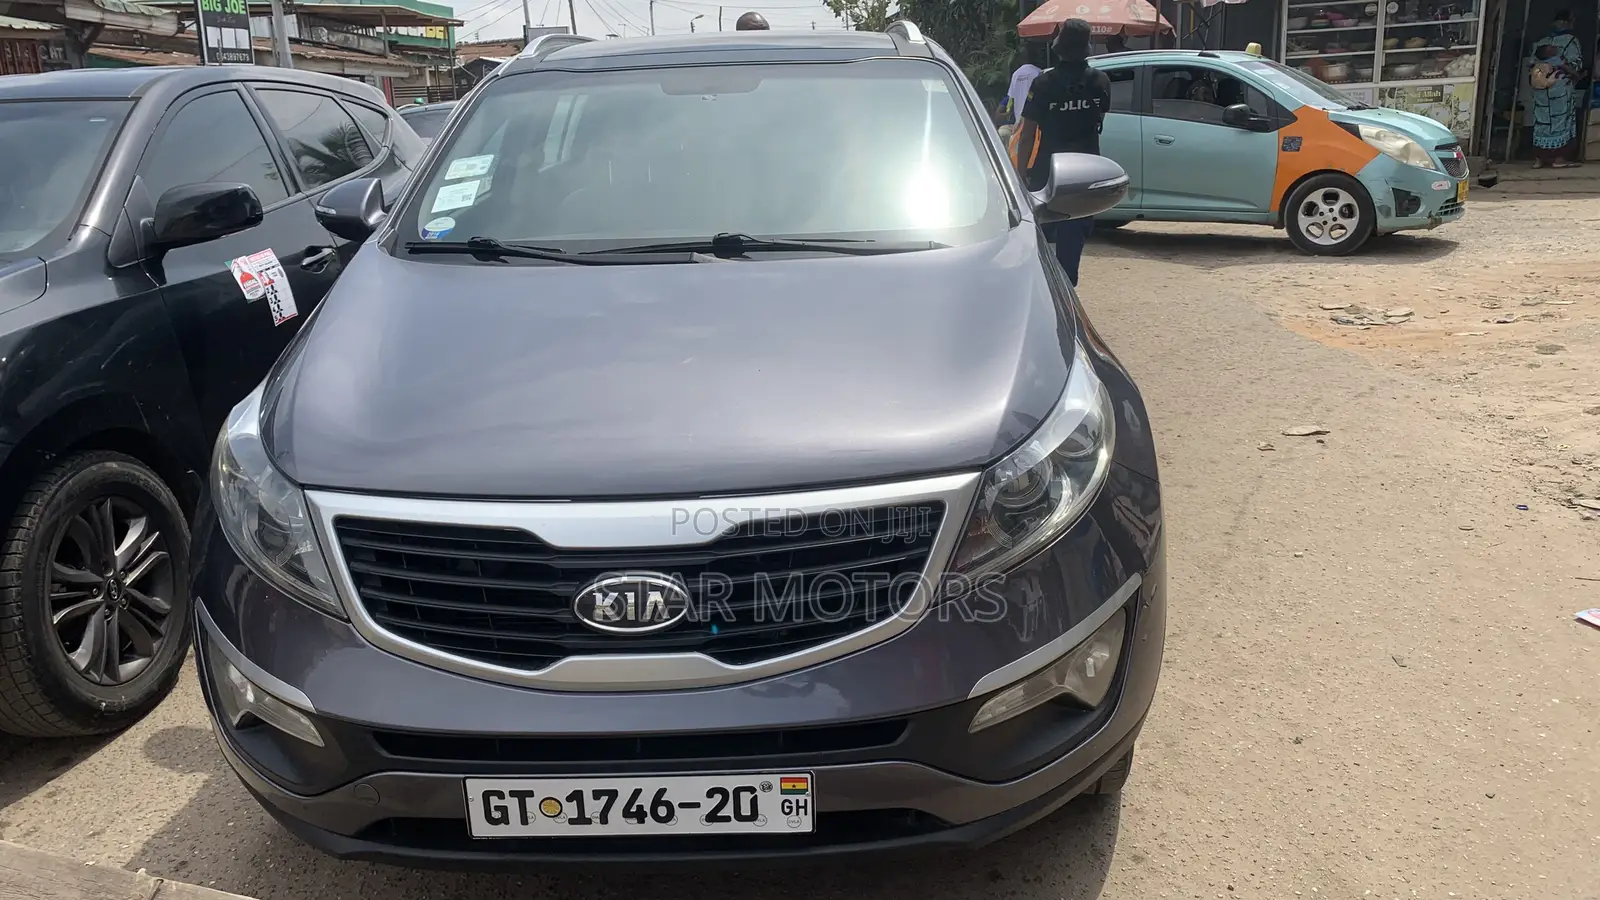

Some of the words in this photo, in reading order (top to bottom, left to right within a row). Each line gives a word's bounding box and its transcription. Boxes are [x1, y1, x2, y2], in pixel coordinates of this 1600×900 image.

[202, 0, 222, 12] BIG
[225, 0, 246, 14] JOE
[592, 591, 670, 621] KIA
[482, 789, 535, 826] GT
[565, 785, 759, 826] 1746-20
[781, 798, 808, 816] GH
